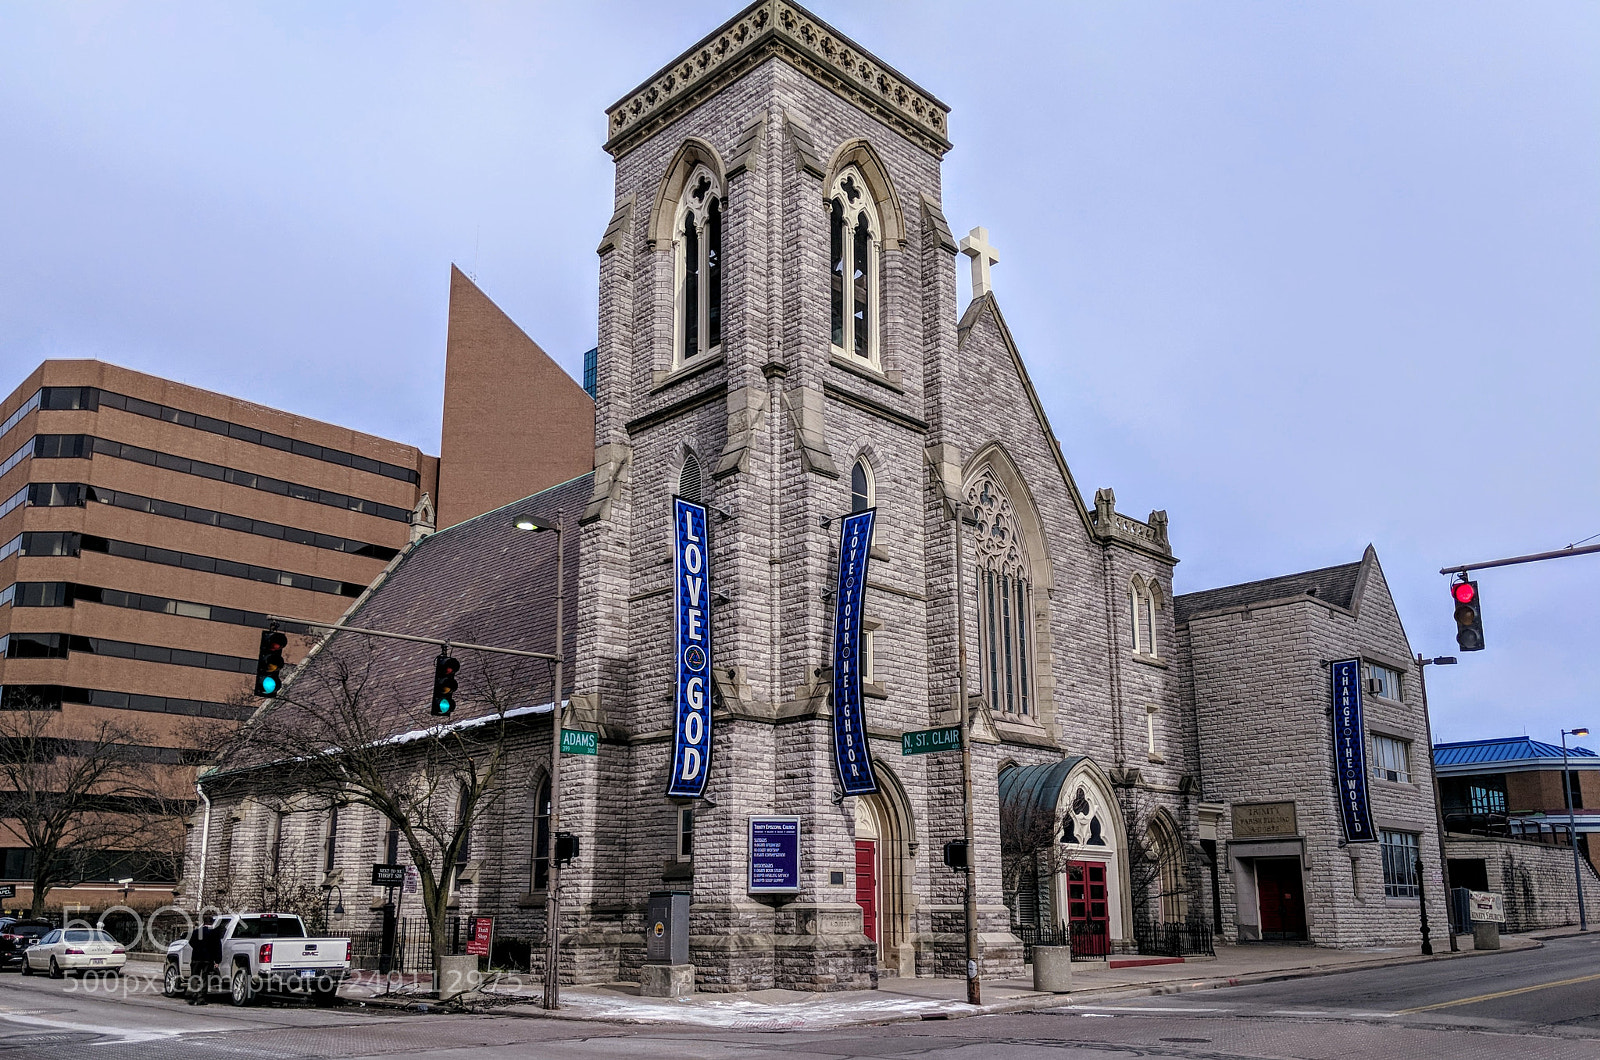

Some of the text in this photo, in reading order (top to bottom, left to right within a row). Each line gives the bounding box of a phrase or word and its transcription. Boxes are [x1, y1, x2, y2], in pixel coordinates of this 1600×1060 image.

[681, 511, 704, 781] LOVE GOD
[843, 523, 860, 777] LOVE YOUR NEIGHBOR
[563, 732, 595, 747] ADAMS
[904, 729, 960, 748] N. ST. CLAIR
[1342, 666, 1362, 833] CHANGE THE WORLD
